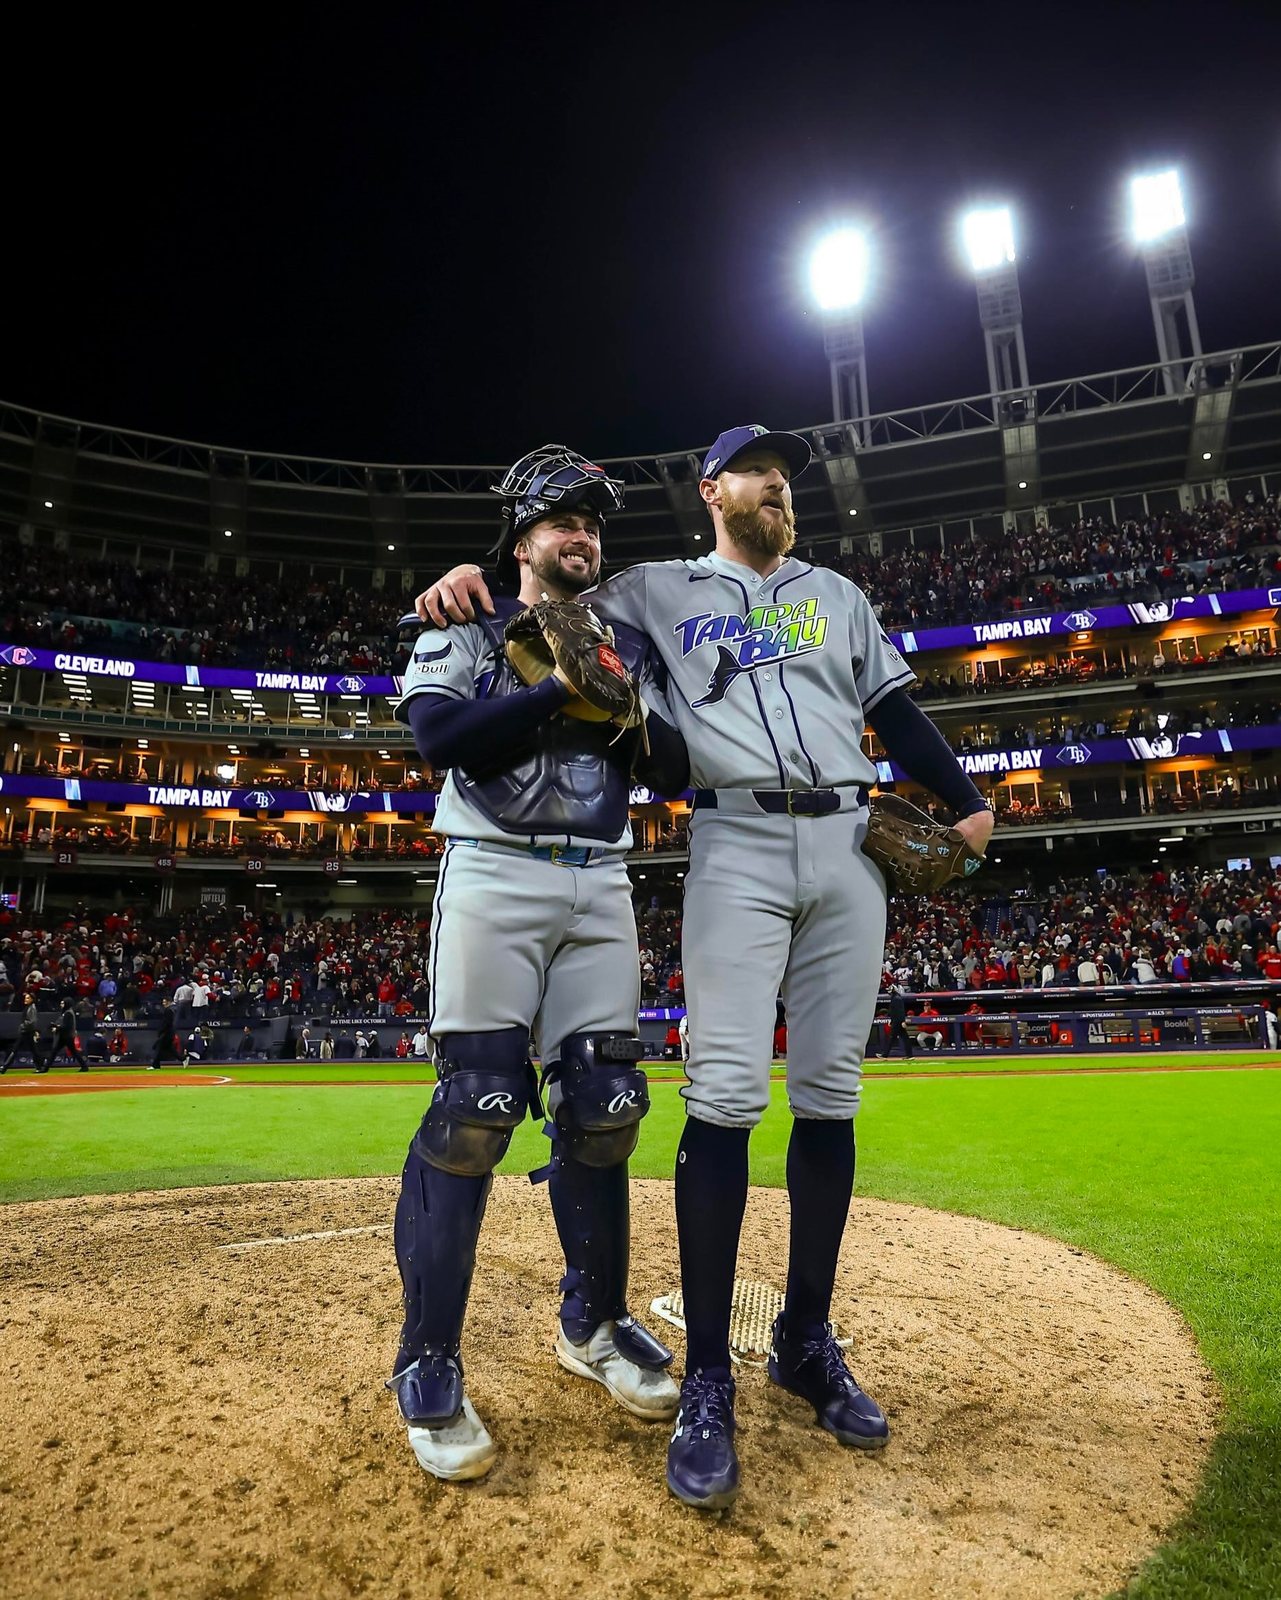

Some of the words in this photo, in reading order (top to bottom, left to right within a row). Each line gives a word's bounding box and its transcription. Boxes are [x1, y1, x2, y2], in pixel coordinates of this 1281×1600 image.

[674, 596, 820, 659] TAMPA
[973, 621, 1022, 642] TAMPA
[1023, 617, 1052, 635] BAY
[732, 615, 829, 667] BAY
[55, 654, 135, 677] CLEVELAND
[416, 664, 448, 674] bull
[255, 673, 300, 690] TAMPA
[301, 675, 328, 691] BAY
[956, 752, 1010, 774] TAMPA
[1011, 749, 1043, 769] BAY
[148, 787, 200, 806] TAMPA
[201, 790, 232, 807] BAY
[59, 853, 72, 864] 21
[247, 861, 262, 870] 20
[326, 862, 339, 871] 25
